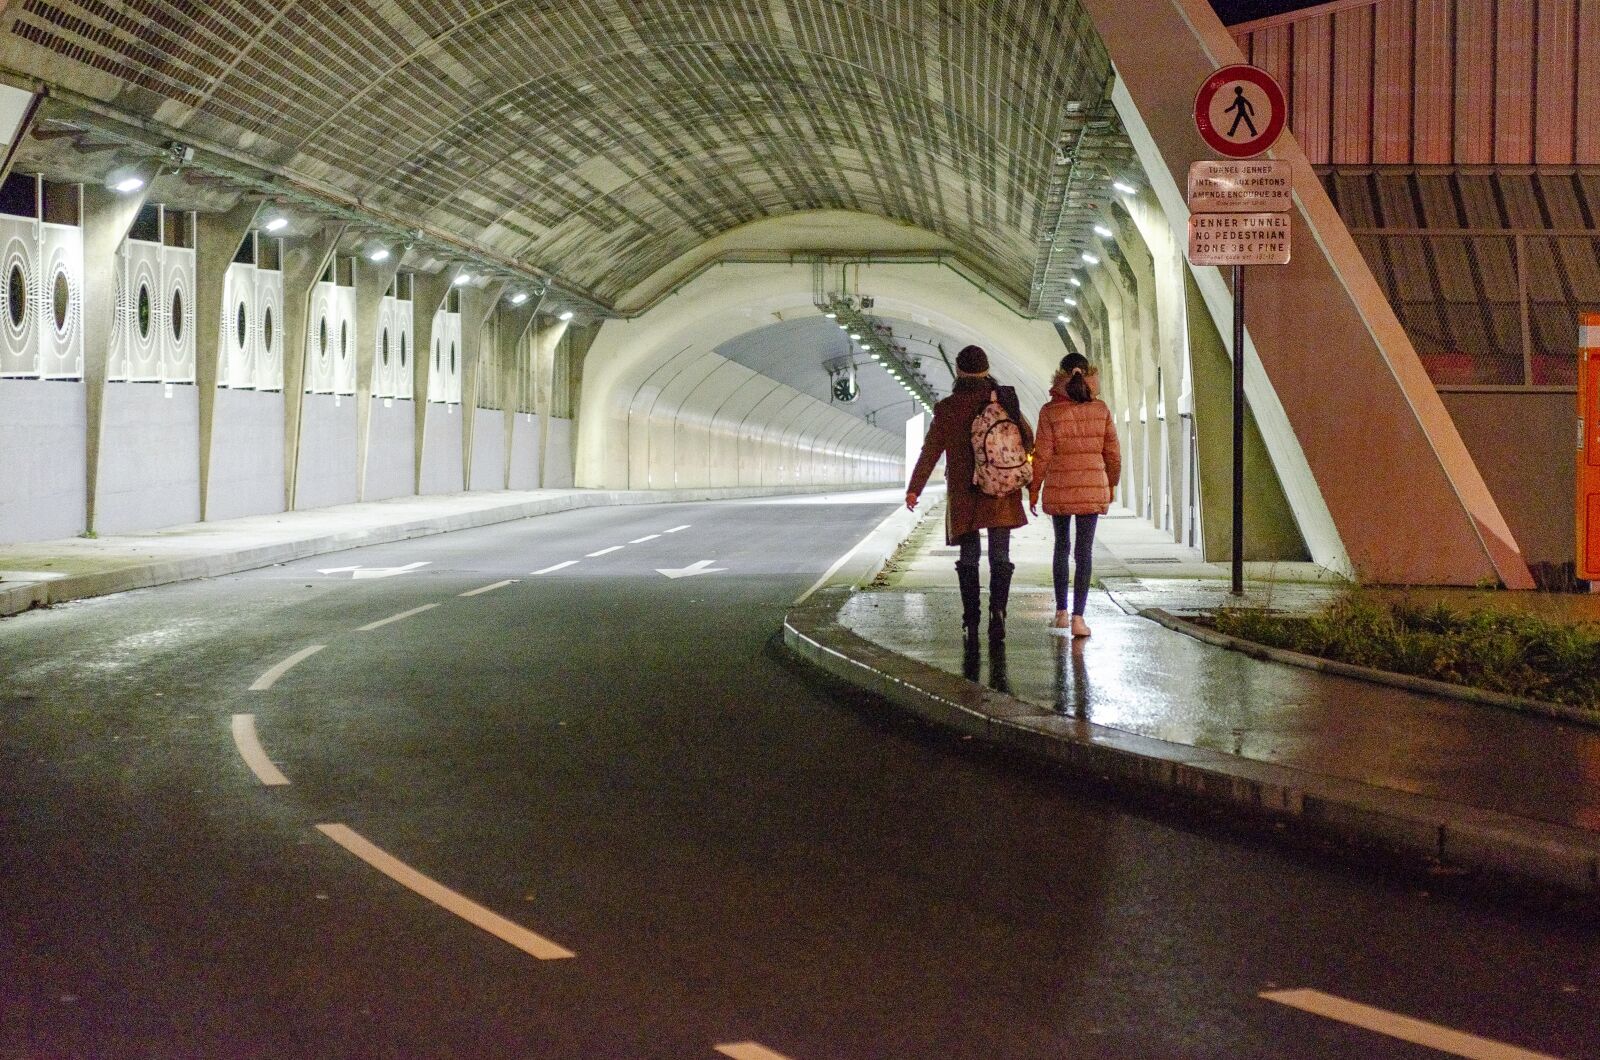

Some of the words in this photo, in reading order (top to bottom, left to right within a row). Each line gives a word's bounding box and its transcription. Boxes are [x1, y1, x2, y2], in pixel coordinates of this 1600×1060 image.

[1251, 177, 1285, 186] PIÉTONS
[1271, 190, 1282, 198] 38
[1193, 218, 1238, 228] JENNER
[1243, 218, 1288, 227] TUNNEL
[1195, 231, 1210, 240] NO
[1215, 231, 1285, 240] PEDESTRIAN
[1196, 244, 1226, 253] ZONE
[1258, 243, 1284, 252] FINE
